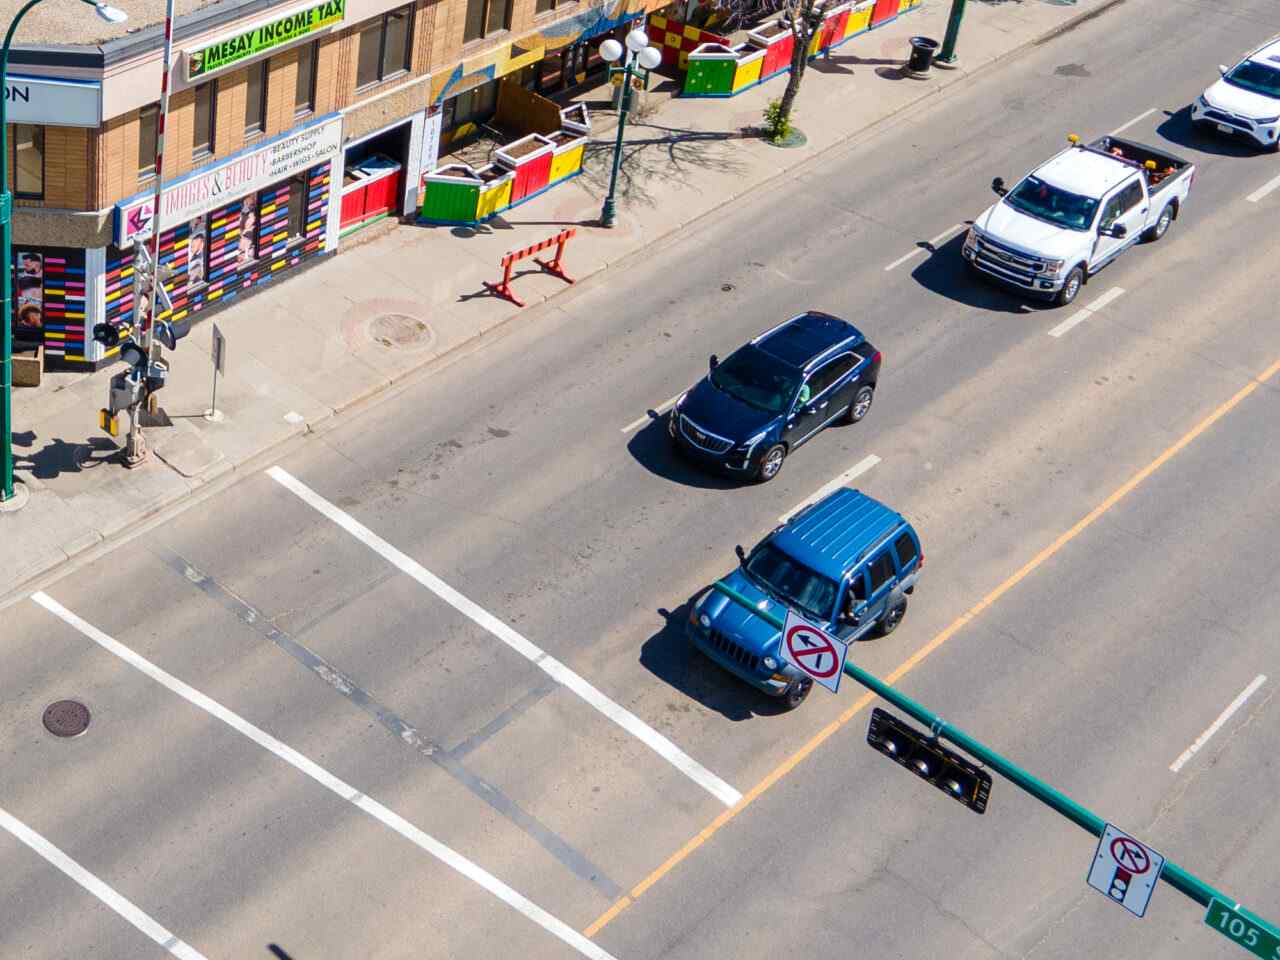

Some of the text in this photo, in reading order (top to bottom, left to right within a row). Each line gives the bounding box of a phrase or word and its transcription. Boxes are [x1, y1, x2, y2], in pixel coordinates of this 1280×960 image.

[207, 31, 255, 65] MESAY
[259, 11, 314, 44] INCOME
[211, 172, 222, 197] &
[1219, 911, 1261, 947] 105
